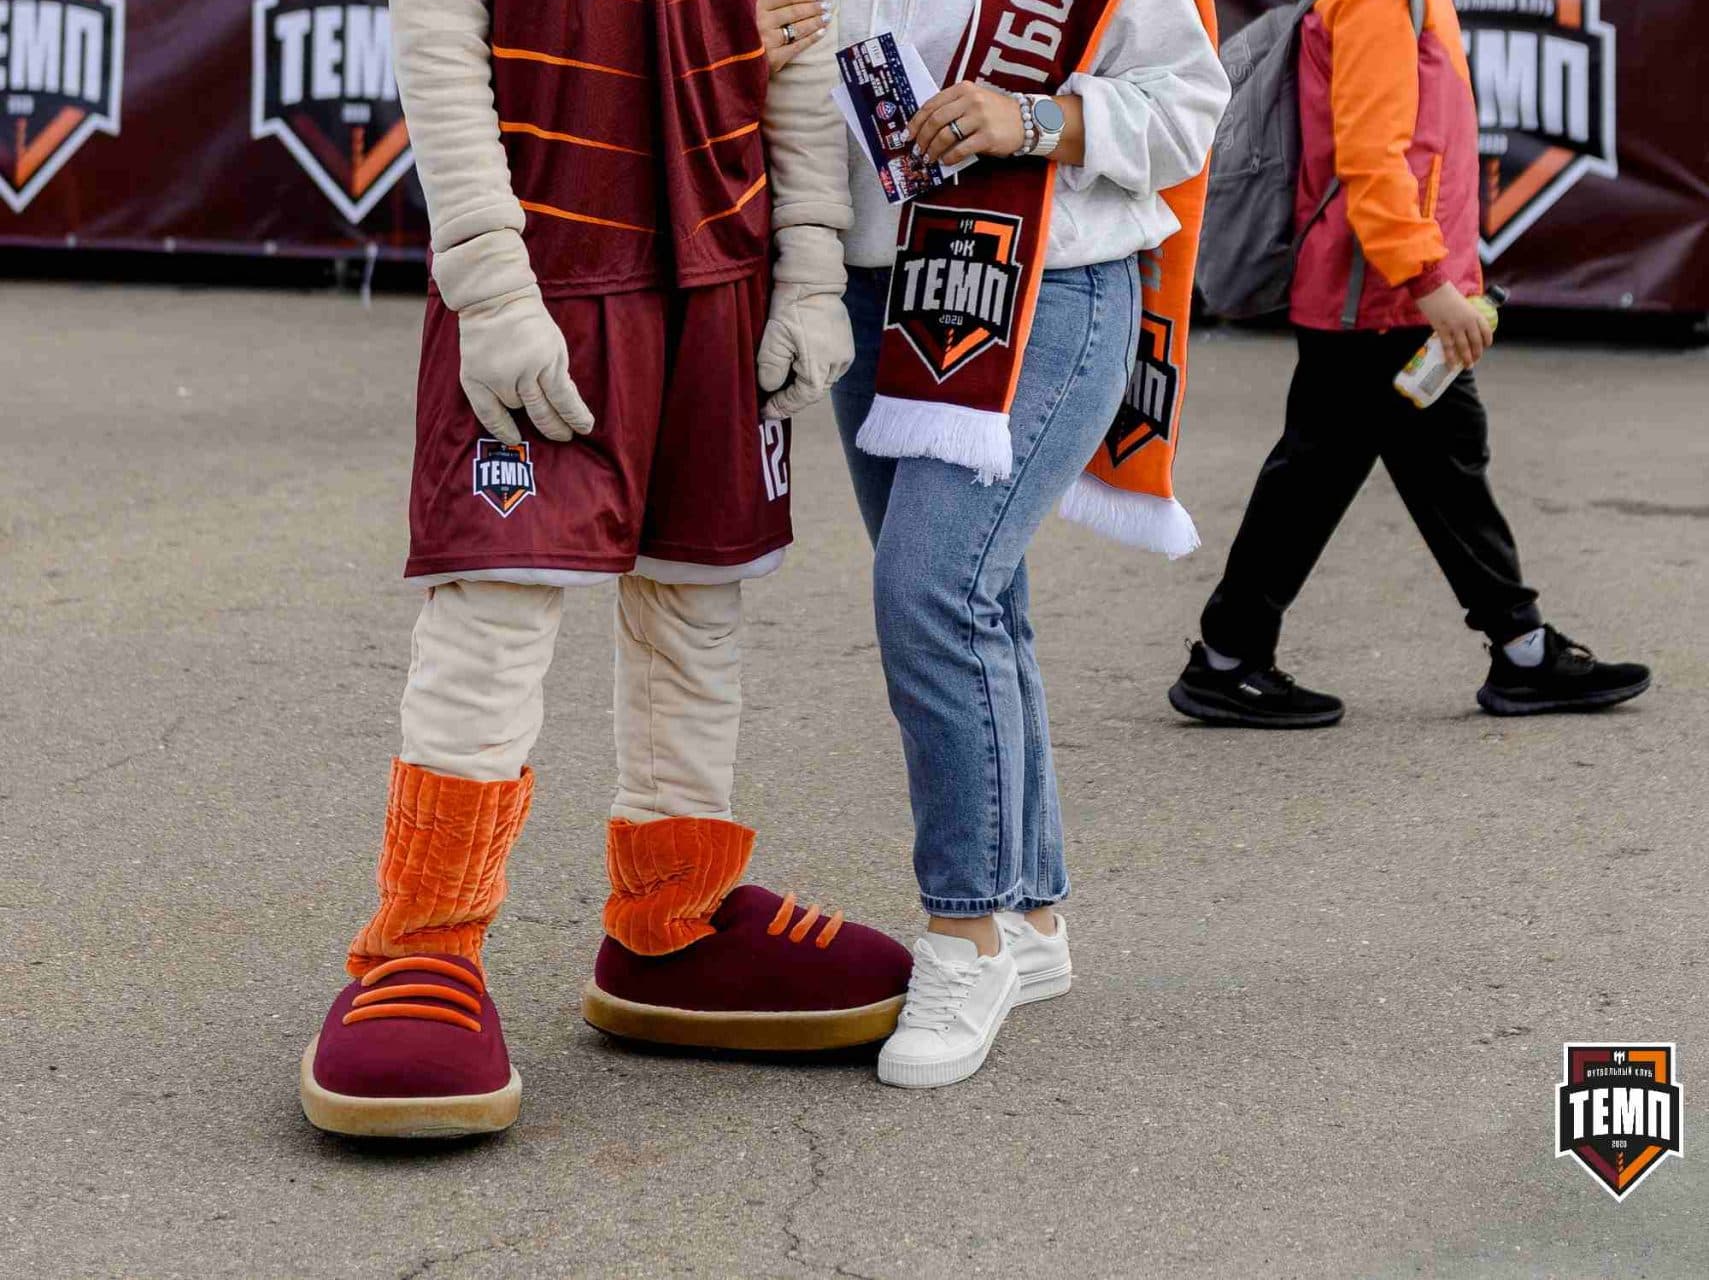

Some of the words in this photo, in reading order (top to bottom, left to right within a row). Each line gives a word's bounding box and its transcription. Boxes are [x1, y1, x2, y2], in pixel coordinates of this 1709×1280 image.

[274, 3, 400, 107] ТЕМ
[1461, 28, 1590, 143] МП
[950, 239, 975, 257] ФК
[903, 257, 1009, 326] ТЕМП
[480, 460, 530, 488] ТЕМП
[759, 419, 788, 501] 12
